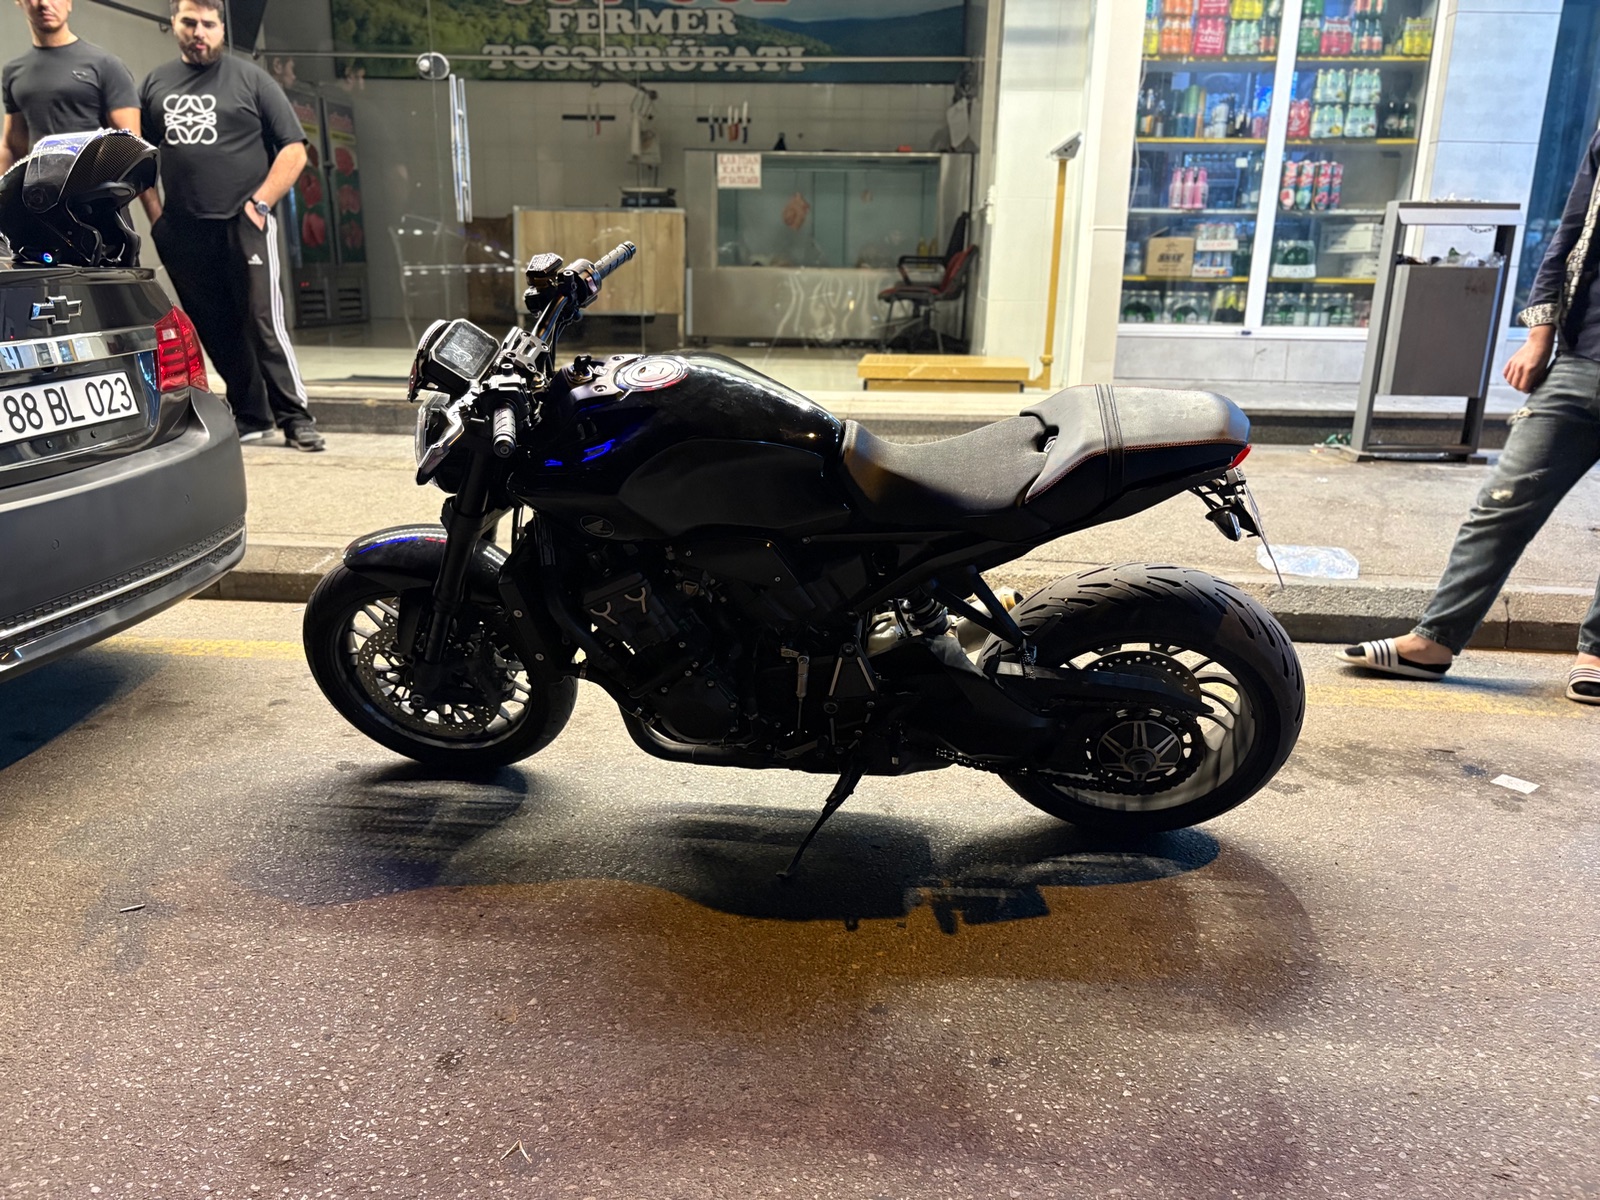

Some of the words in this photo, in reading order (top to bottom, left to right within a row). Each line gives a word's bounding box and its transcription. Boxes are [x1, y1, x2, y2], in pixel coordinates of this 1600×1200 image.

[547, 8, 738, 35] FERMER
[481, 39, 806, 72] TƏSƏRRÜFATI
[3, 392, 43, 434] 88
[43, 386, 86, 426] BL
[85, 377, 132, 417] 023
